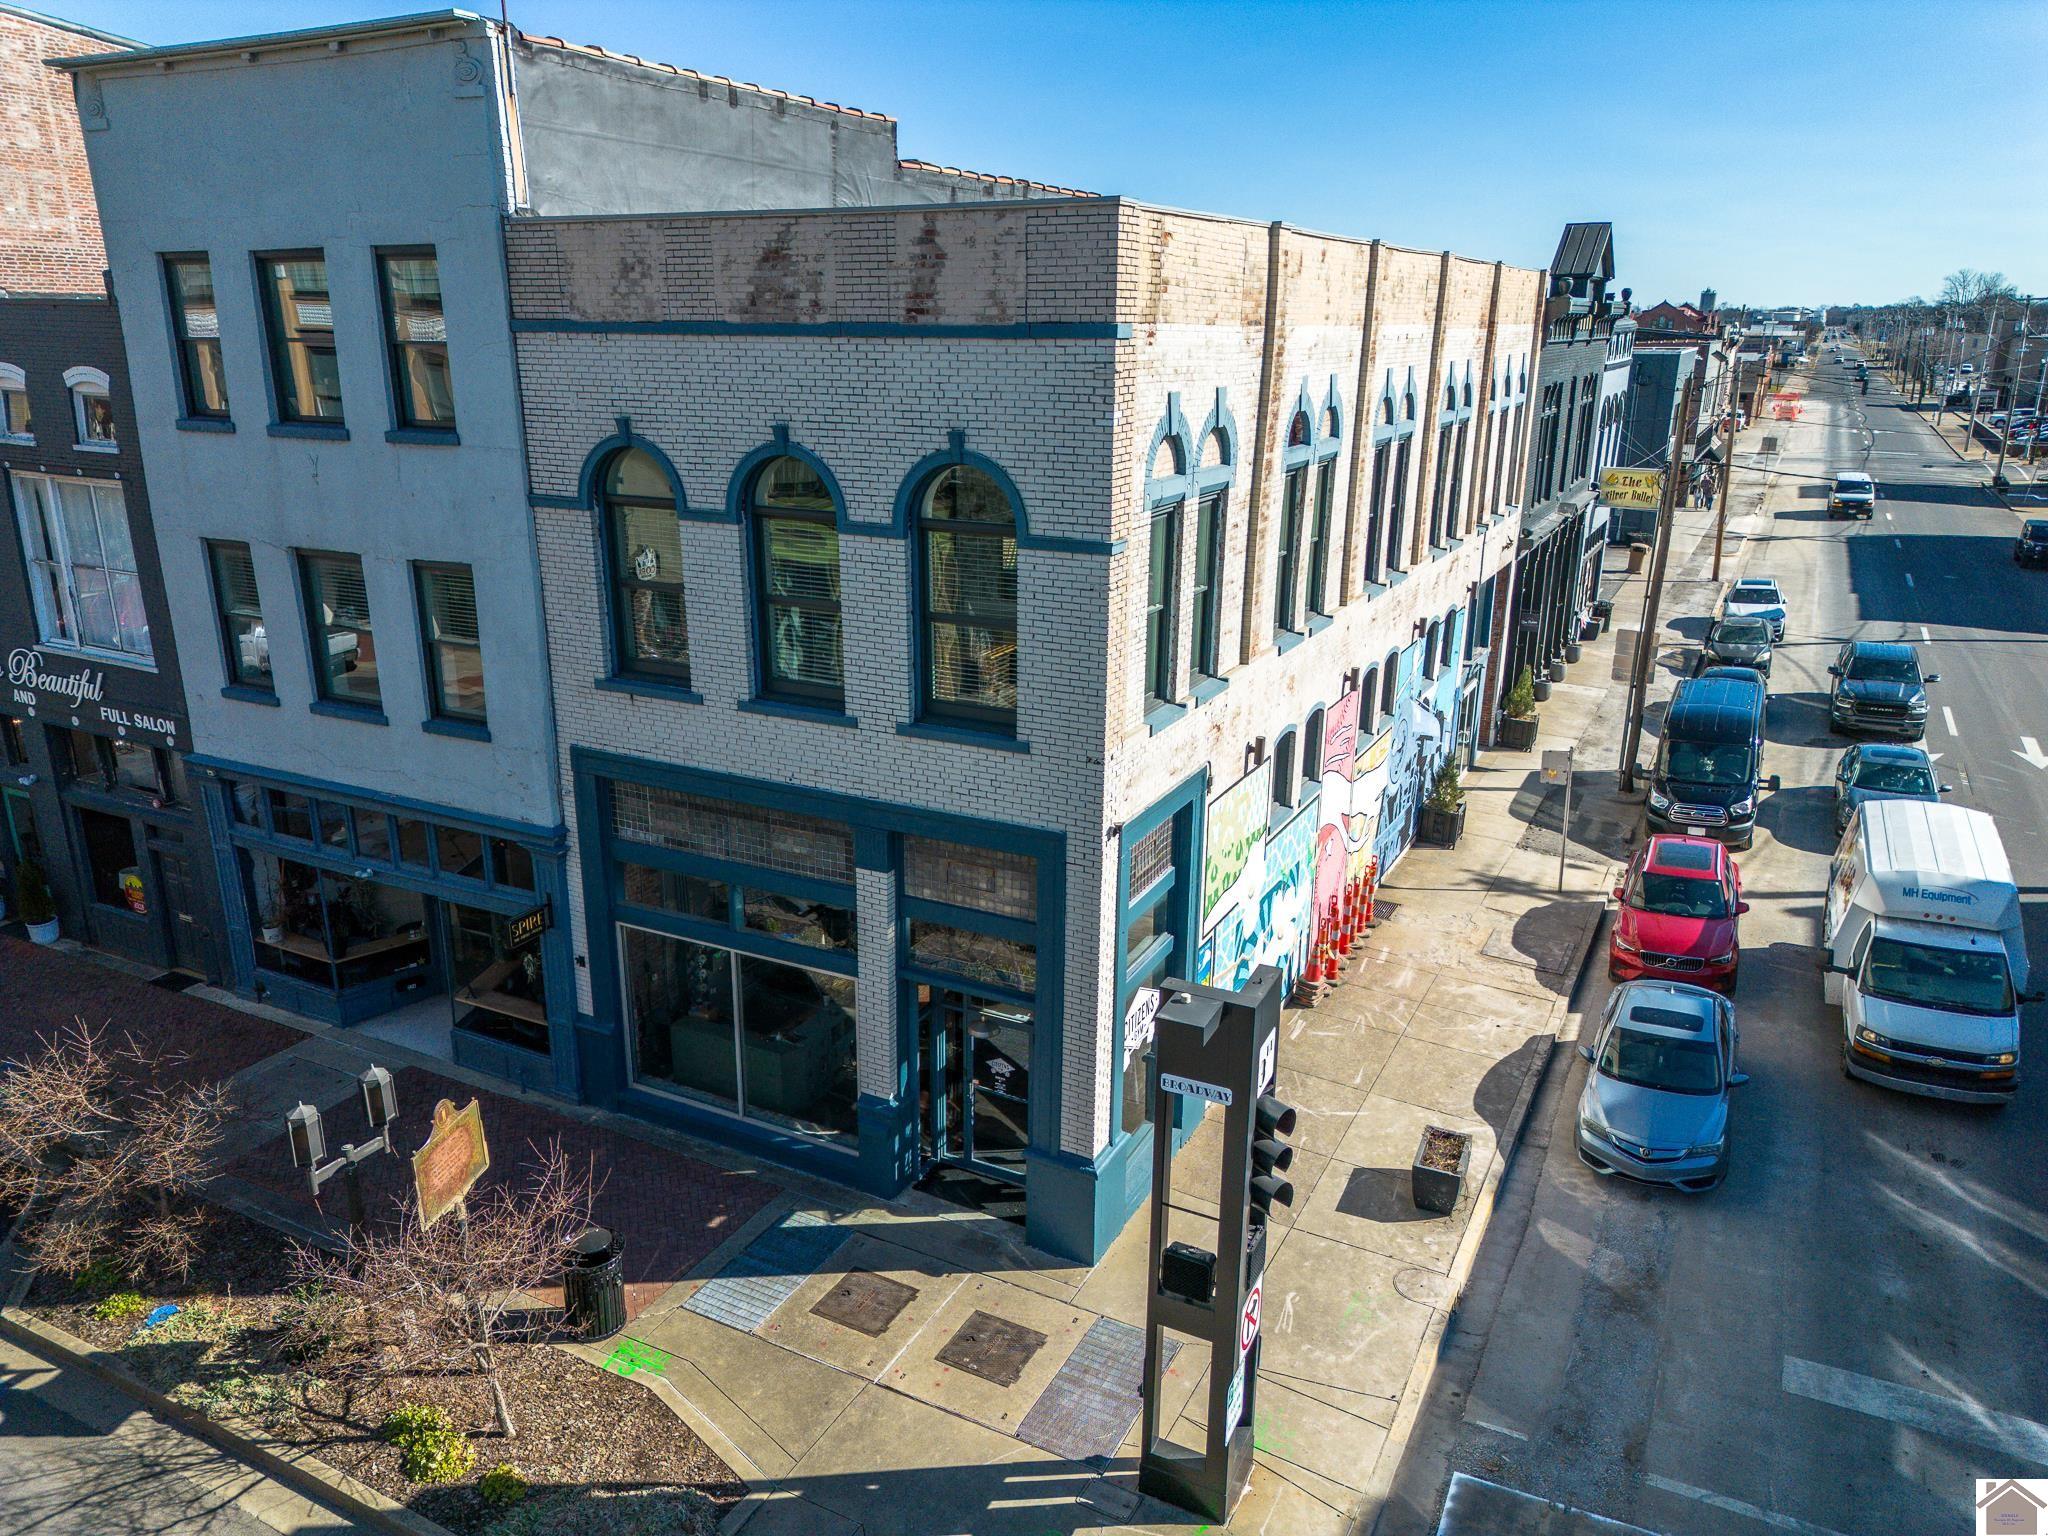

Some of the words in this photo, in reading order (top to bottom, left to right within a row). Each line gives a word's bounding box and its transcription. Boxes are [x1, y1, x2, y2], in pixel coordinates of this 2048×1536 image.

[1622, 476, 1642, 487] The
[8, 648, 104, 708] Beautiful
[13, 689, 36, 706] AND
[100, 706, 132, 726] FULL
[133, 713, 176, 735] SALON
[1902, 887, 1919, 898] MH
[1921, 889, 1972, 905] Equipment
[1162, 1078, 1232, 1103] BROADWAY
